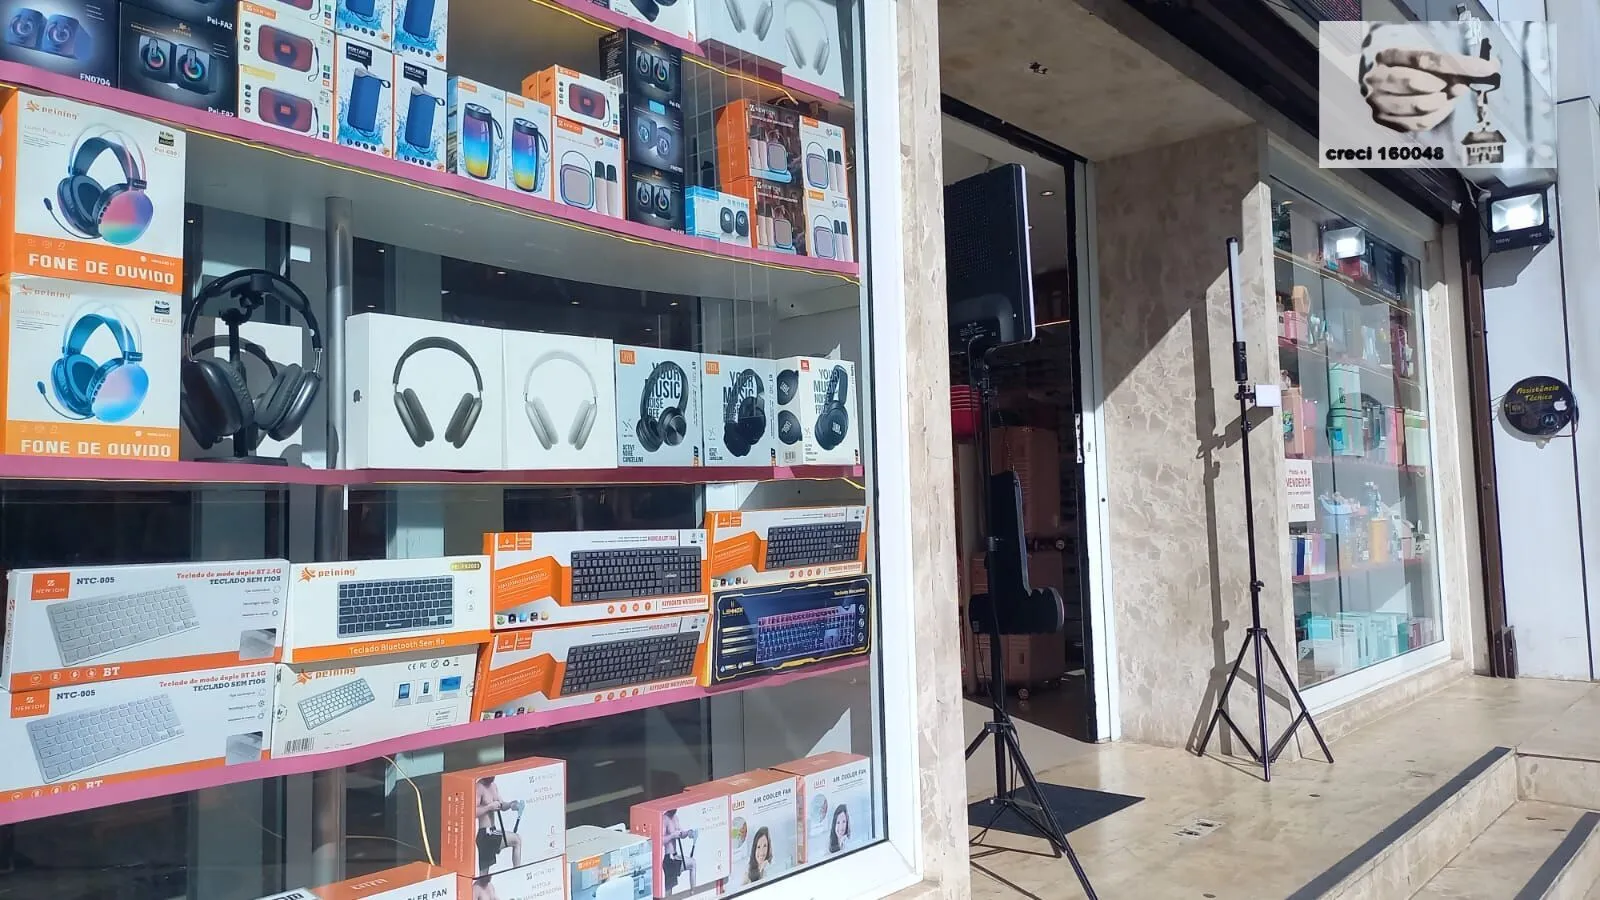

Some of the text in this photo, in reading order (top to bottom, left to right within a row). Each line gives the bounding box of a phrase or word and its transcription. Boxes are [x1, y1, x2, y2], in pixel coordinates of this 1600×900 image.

[206, 16, 233, 30] Pei-FA2
[80, 72, 111, 87] FN0704
[41, 106, 78, 120] peining
[28, 253, 175, 285] FONE DE OUVIDO
[20, 439, 171, 457] FONE DE OUVIDO
[263, 575, 281, 583] FIOS
[318, 568, 356, 578] peining
[76, 576, 115, 585] NTC-005
[350, 645, 379, 656] Teclado
[380, 641, 418, 652] Bluetooth
[419, 639, 434, 647] Sem
[103, 666, 120, 677] BT
[159, 679, 188, 687] Teclado
[193, 682, 230, 692] TECLADO
[230, 680, 247, 688] SEM
[56, 689, 96, 700] NTC-005
[762, 791, 782, 802] COOLER
[782, 788, 792, 796] FAN
[431, 888, 448, 899] FAN
